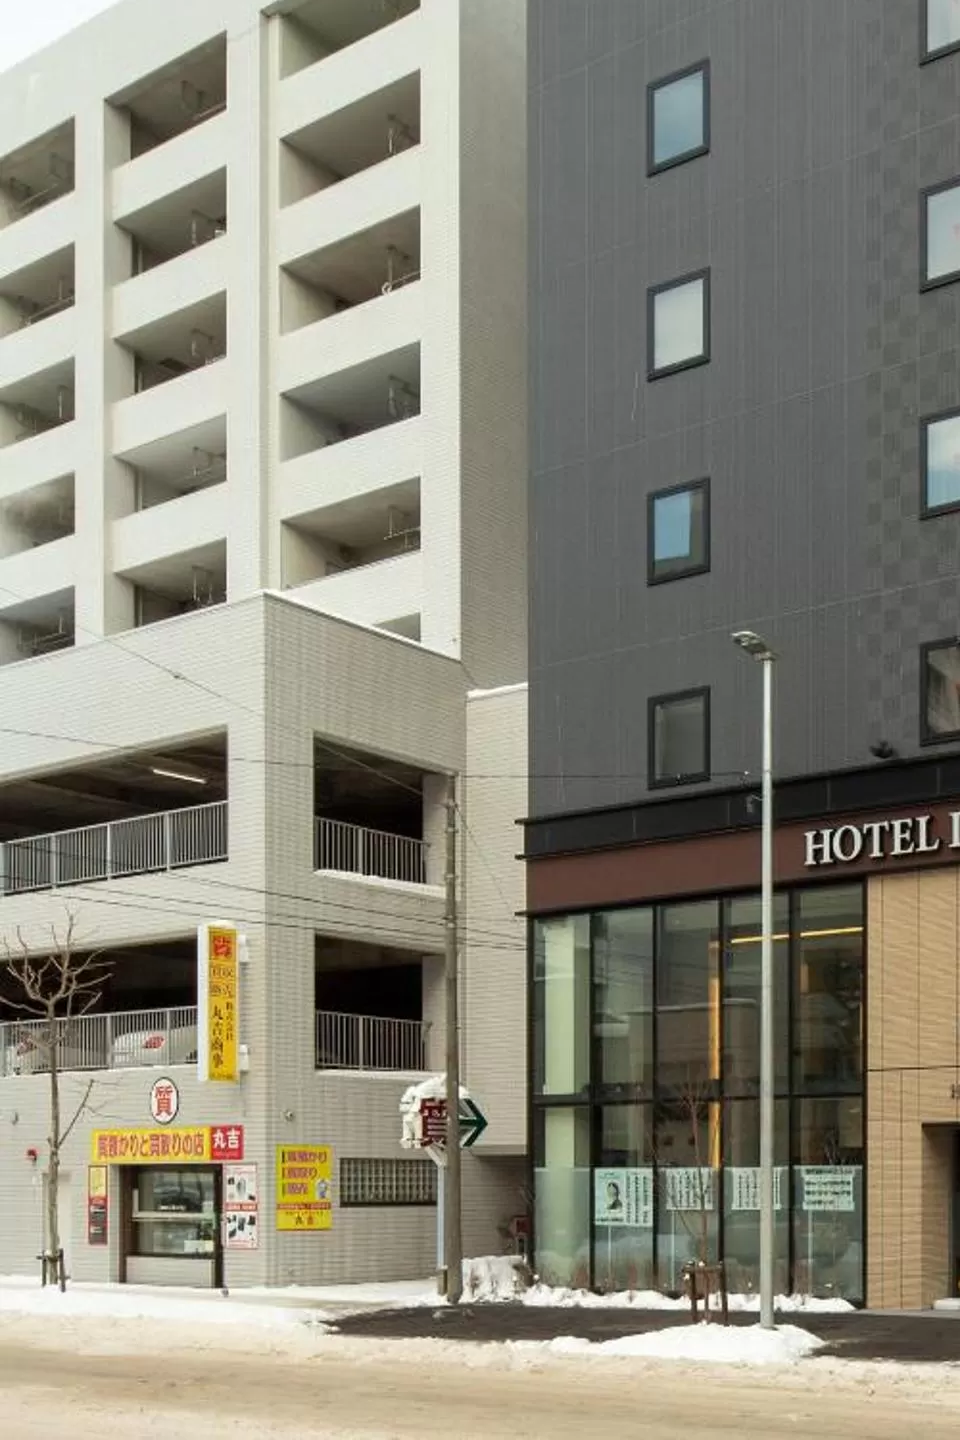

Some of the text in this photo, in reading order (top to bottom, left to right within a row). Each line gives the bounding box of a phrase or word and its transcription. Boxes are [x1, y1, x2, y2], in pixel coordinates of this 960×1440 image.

[803, 815, 940, 867] HOTEL
[155, 1085, 173, 1116] 質
[212, 1129, 241, 1150] 丸吉
